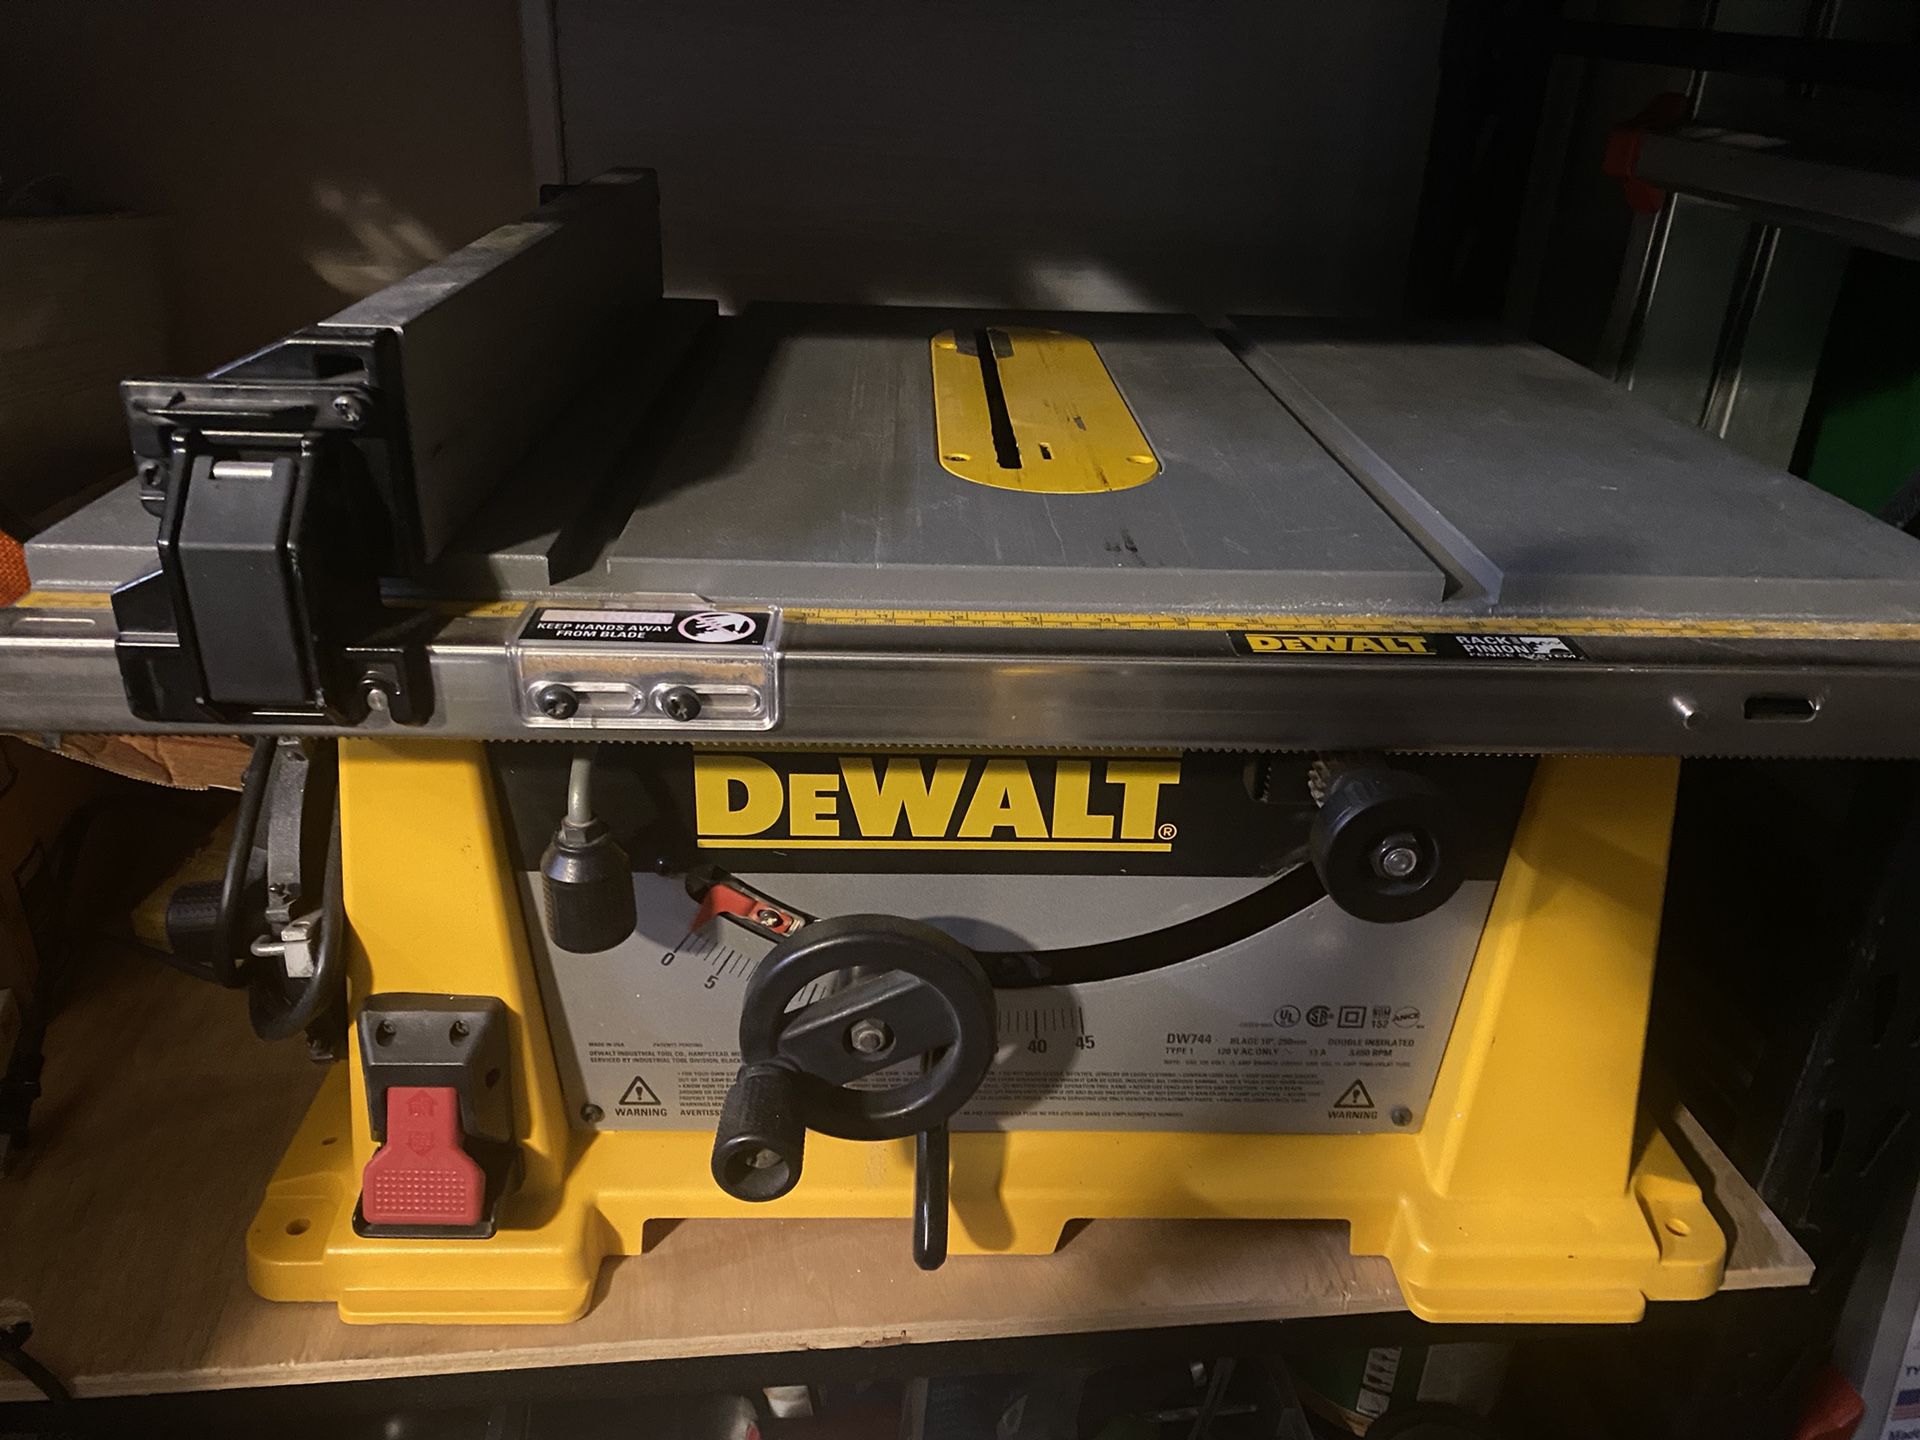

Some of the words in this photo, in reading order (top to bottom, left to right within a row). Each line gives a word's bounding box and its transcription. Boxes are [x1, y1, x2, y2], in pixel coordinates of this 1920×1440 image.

[536, 622, 573, 631] KEEP
[575, 623, 625, 632] HANDS
[628, 624, 673, 633] AWAY
[556, 630, 597, 638] FROM
[600, 631, 647, 640] BLADE
[1456, 635, 1511, 645] RACK
[1245, 635, 1430, 652] DEWALT
[1463, 644, 1531, 654] PINION
[694, 755, 1181, 840] DEWALT
[661, 952, 675, 967] 0
[704, 975, 719, 990] 5
[1074, 1035, 1095, 1051] 45
[1167, 1033, 1212, 1044] DW744
[1027, 1038, 1048, 1054] 40
[1166, 1047, 1186, 1055] TYPE
[615, 1108, 668, 1117] WARNING
[1327, 1110, 1379, 1120] WARNING
